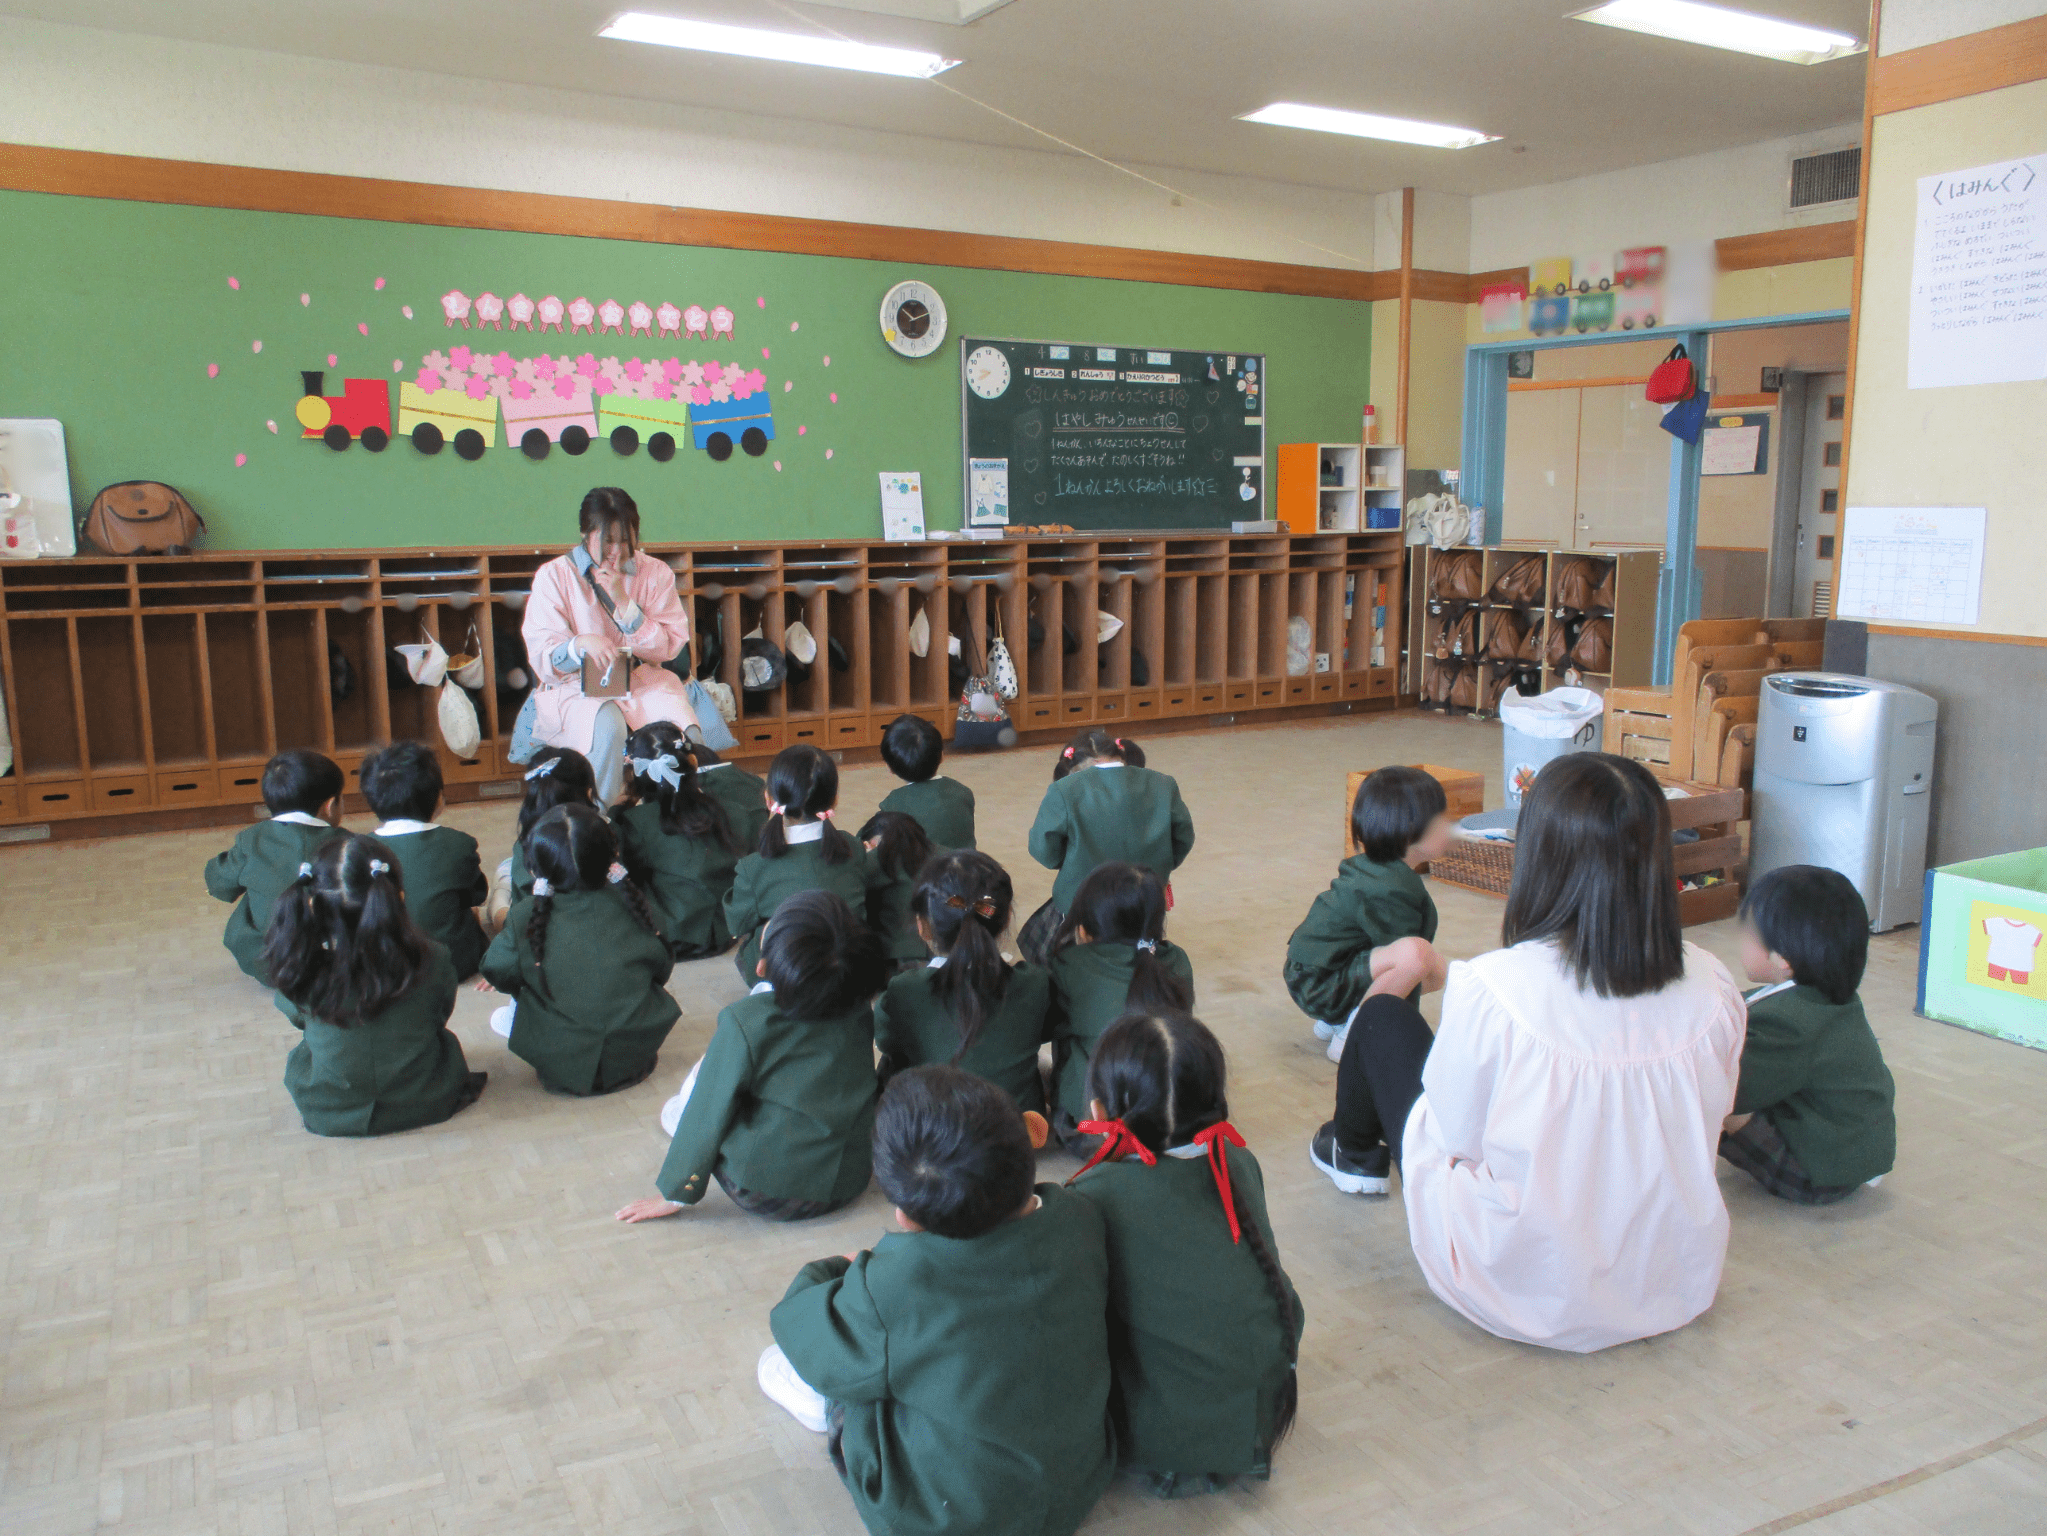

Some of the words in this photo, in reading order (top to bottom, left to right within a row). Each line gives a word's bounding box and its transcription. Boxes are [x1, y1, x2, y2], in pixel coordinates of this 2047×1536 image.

[1035, 369, 1063, 378] しぎょうしき
